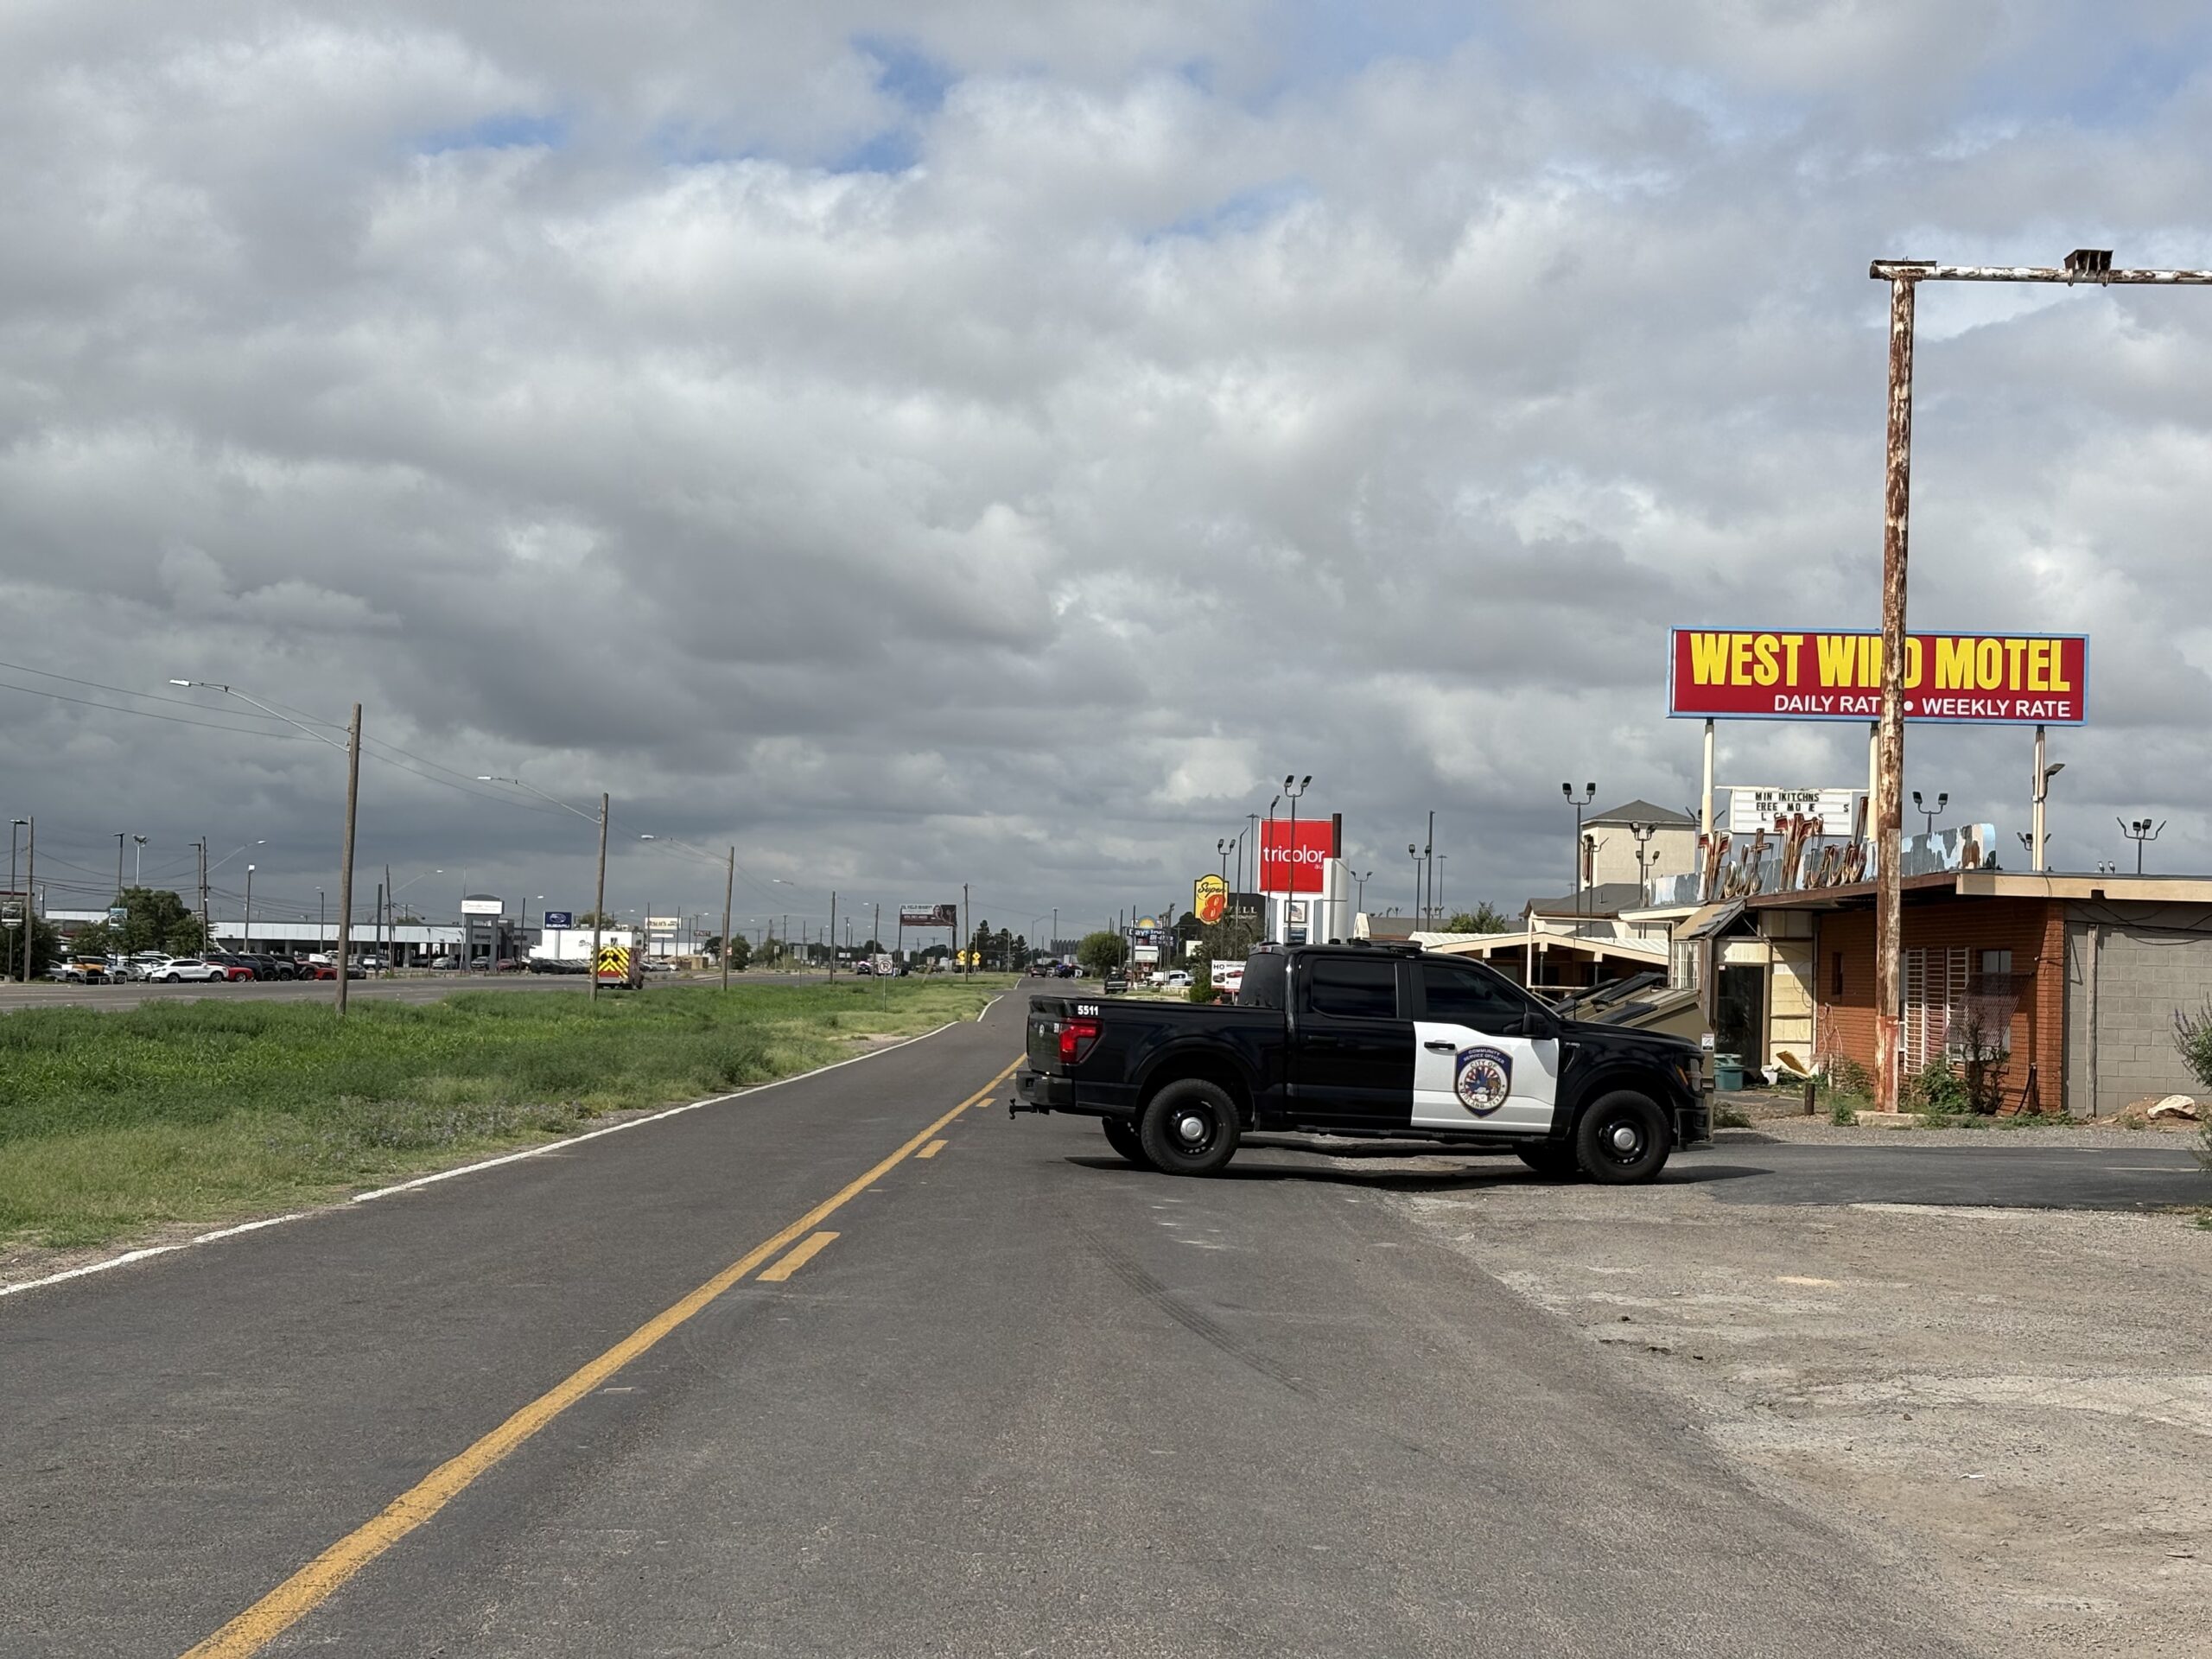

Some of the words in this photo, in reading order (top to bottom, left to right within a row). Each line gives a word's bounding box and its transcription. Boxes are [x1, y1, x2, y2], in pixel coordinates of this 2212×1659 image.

[1690, 633, 1804, 686] WEST
[1936, 638, 2070, 692] MOTEL
[1775, 695, 1834, 712] DAILY
[1840, 696, 1882, 714] RAT
[1922, 697, 2010, 715] WEEKLY
[2016, 700, 2071, 717] RATE
[1263, 844, 1325, 864] tricolor
[1199, 894, 1226, 922] 8
[1077, 1005, 1098, 1015] 5511
